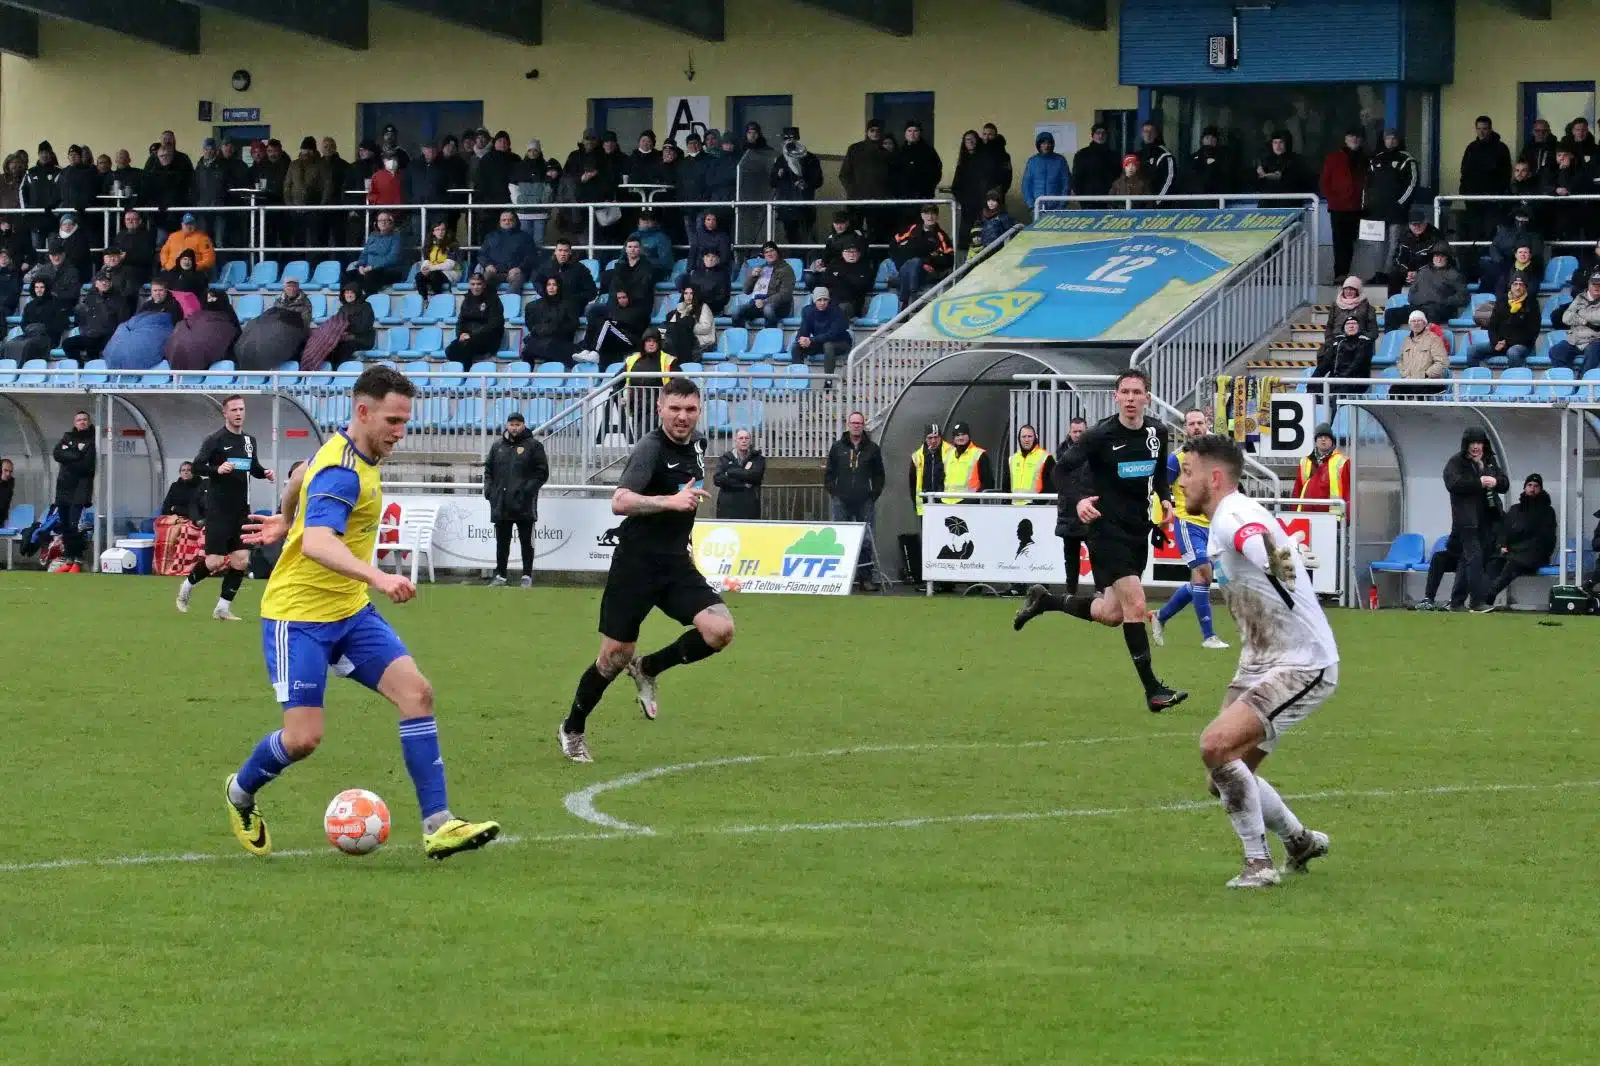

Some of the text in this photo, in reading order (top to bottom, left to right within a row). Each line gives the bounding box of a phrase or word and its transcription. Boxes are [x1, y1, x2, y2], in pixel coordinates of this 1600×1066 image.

[669, 99, 694, 141] A
[1034, 215, 1095, 229] Unsere
[1093, 214, 1138, 229] Fans
[1136, 214, 1180, 230] sind
[1174, 214, 1208, 230] der
[1085, 255, 1158, 284] 12
[947, 295, 1033, 327] FSV
[1271, 400, 1305, 451] B
[718, 559, 760, 575] in TF!
[782, 558, 841, 577] VTF
[754, 580, 820, 593] Teltow-Fläming
[820, 583, 843, 593] mbH
